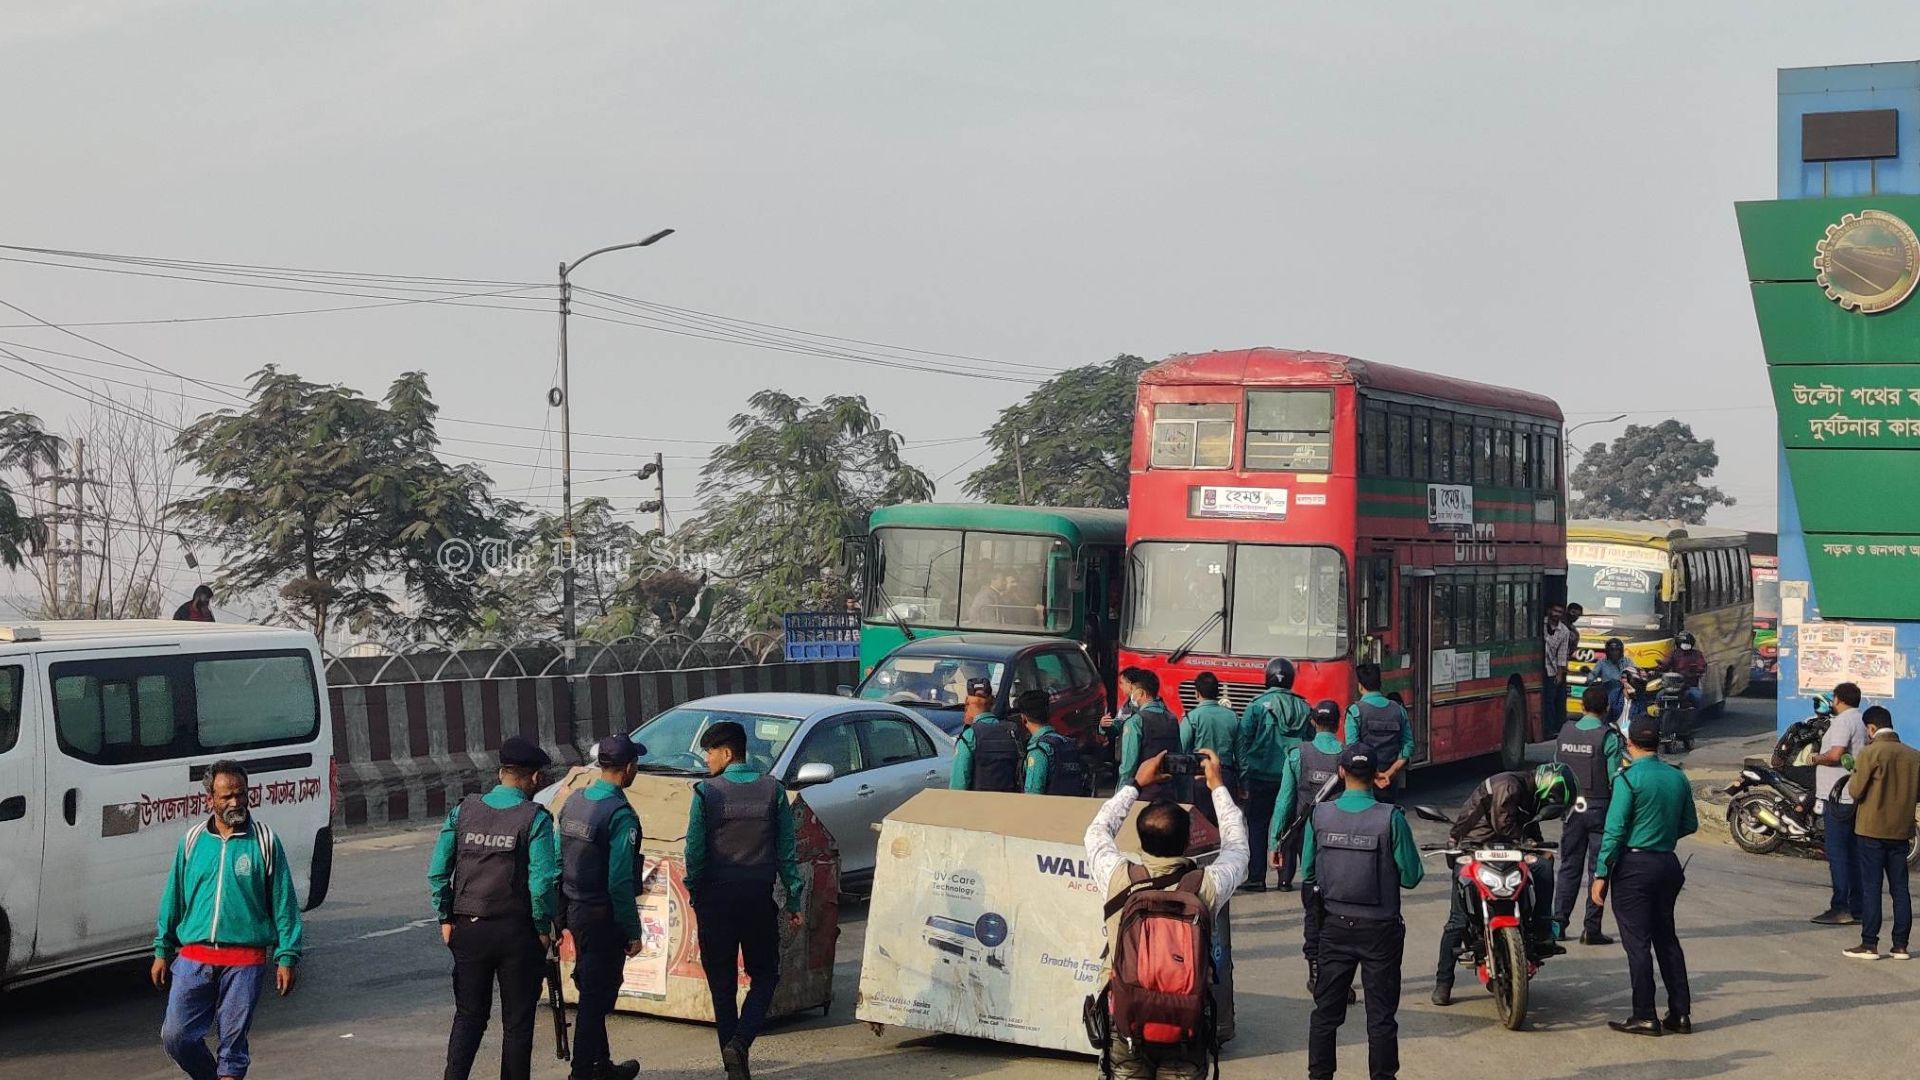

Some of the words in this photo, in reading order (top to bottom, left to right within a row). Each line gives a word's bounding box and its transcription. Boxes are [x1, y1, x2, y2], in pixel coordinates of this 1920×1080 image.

[1791, 382, 1844, 406] উল্টো
[1850, 386, 1903, 406] পথের
[1808, 412, 1883, 441] দুর্ঘটনার
[1225, 489, 1263, 504] হেমন্ত
[1823, 543, 1853, 558] সড়ক
[1856, 544, 1865, 556] ও
[1868, 543, 1907, 557] জনপথ
[1185, 659, 1218, 667] ASHOK
[1222, 660, 1265, 669] LEYLAND
[1561, 743, 1593, 754] POLICE
[464, 832, 515, 848] POLICE
[1036, 854, 1095, 881] WAL
[931, 881, 975, 897] Technology
[1040, 952, 1079, 970] Breathe
[1074, 969, 1094, 983] Live
